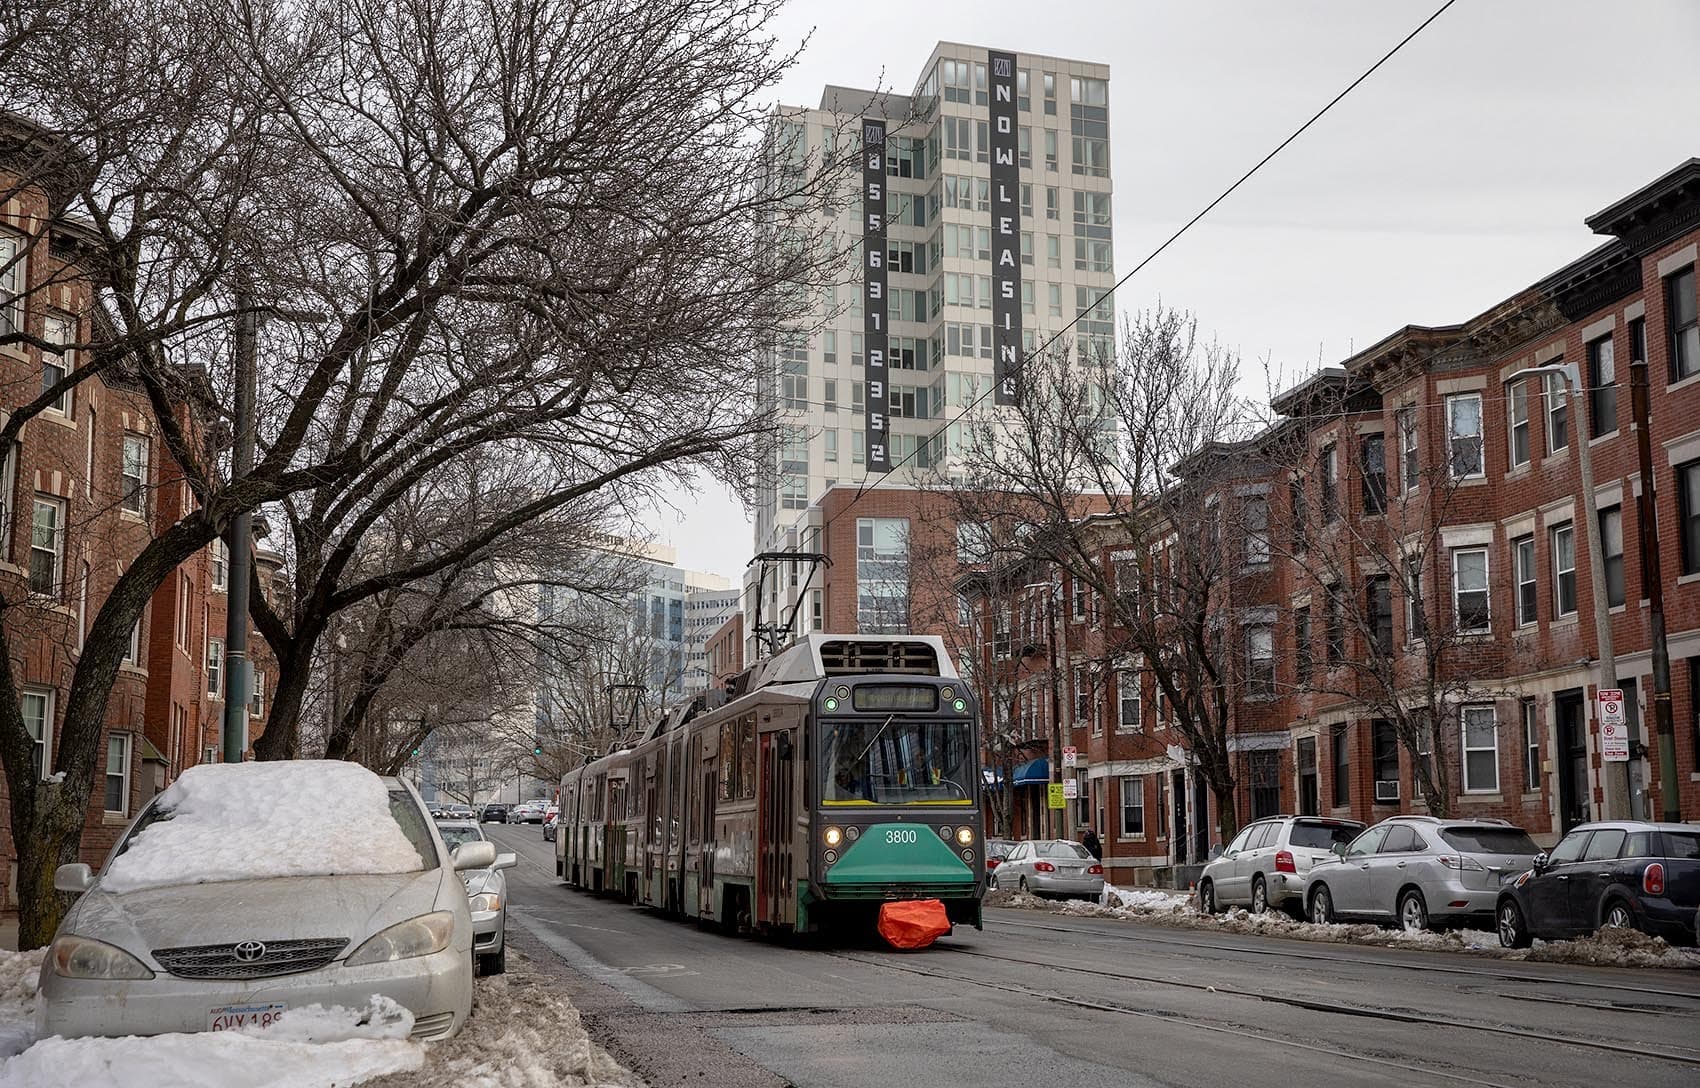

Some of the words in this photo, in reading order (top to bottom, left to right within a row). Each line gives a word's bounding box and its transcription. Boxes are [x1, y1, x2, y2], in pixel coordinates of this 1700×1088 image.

[995, 84, 1014, 166] NOW
[869, 250, 882, 330] 631
[870, 350, 885, 462] 2352
[886, 830, 917, 844] 3800
